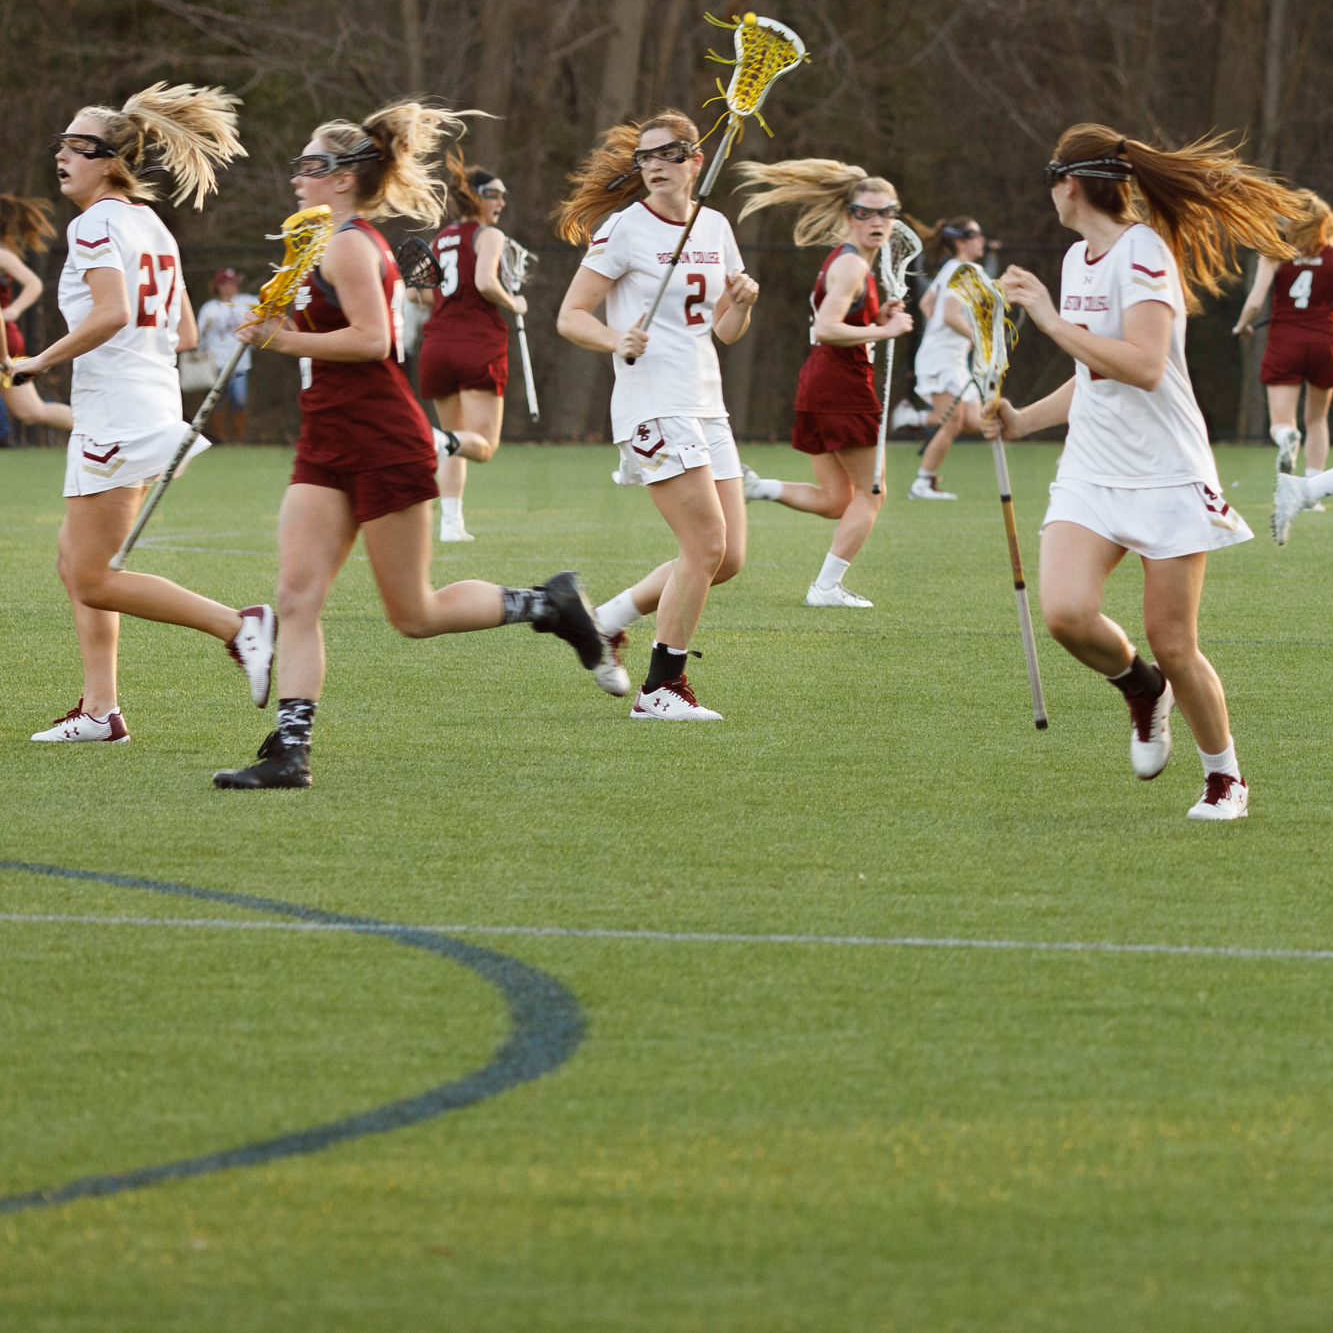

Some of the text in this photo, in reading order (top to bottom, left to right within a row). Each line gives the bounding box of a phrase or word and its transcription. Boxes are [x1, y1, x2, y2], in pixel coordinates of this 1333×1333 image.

[439, 249, 459, 297] 3
[656, 252, 690, 264] BOSON
[136, 252, 176, 328] 27
[685, 273, 706, 326] 2
[1288, 270, 1313, 309] 4
